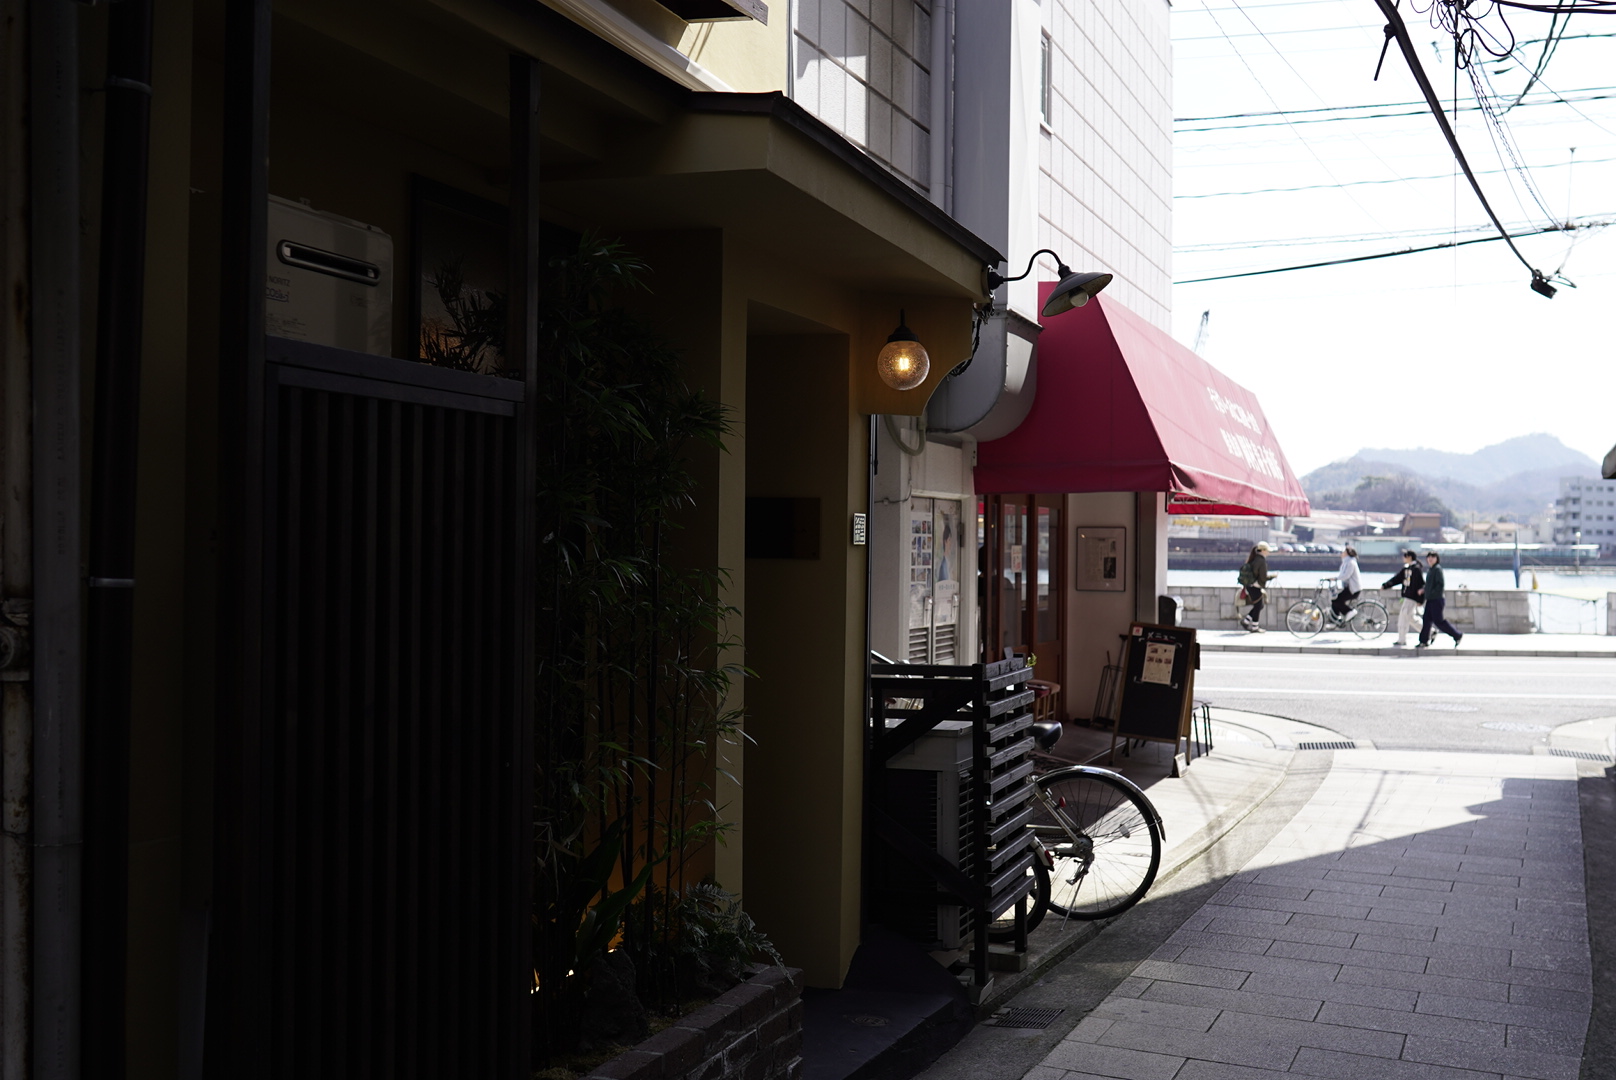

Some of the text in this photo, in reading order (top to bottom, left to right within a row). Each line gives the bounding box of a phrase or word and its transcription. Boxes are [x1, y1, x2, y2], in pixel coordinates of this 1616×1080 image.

[268, 275, 291, 287] NORITZ
[1147, 631, 1177, 641] メニュー
